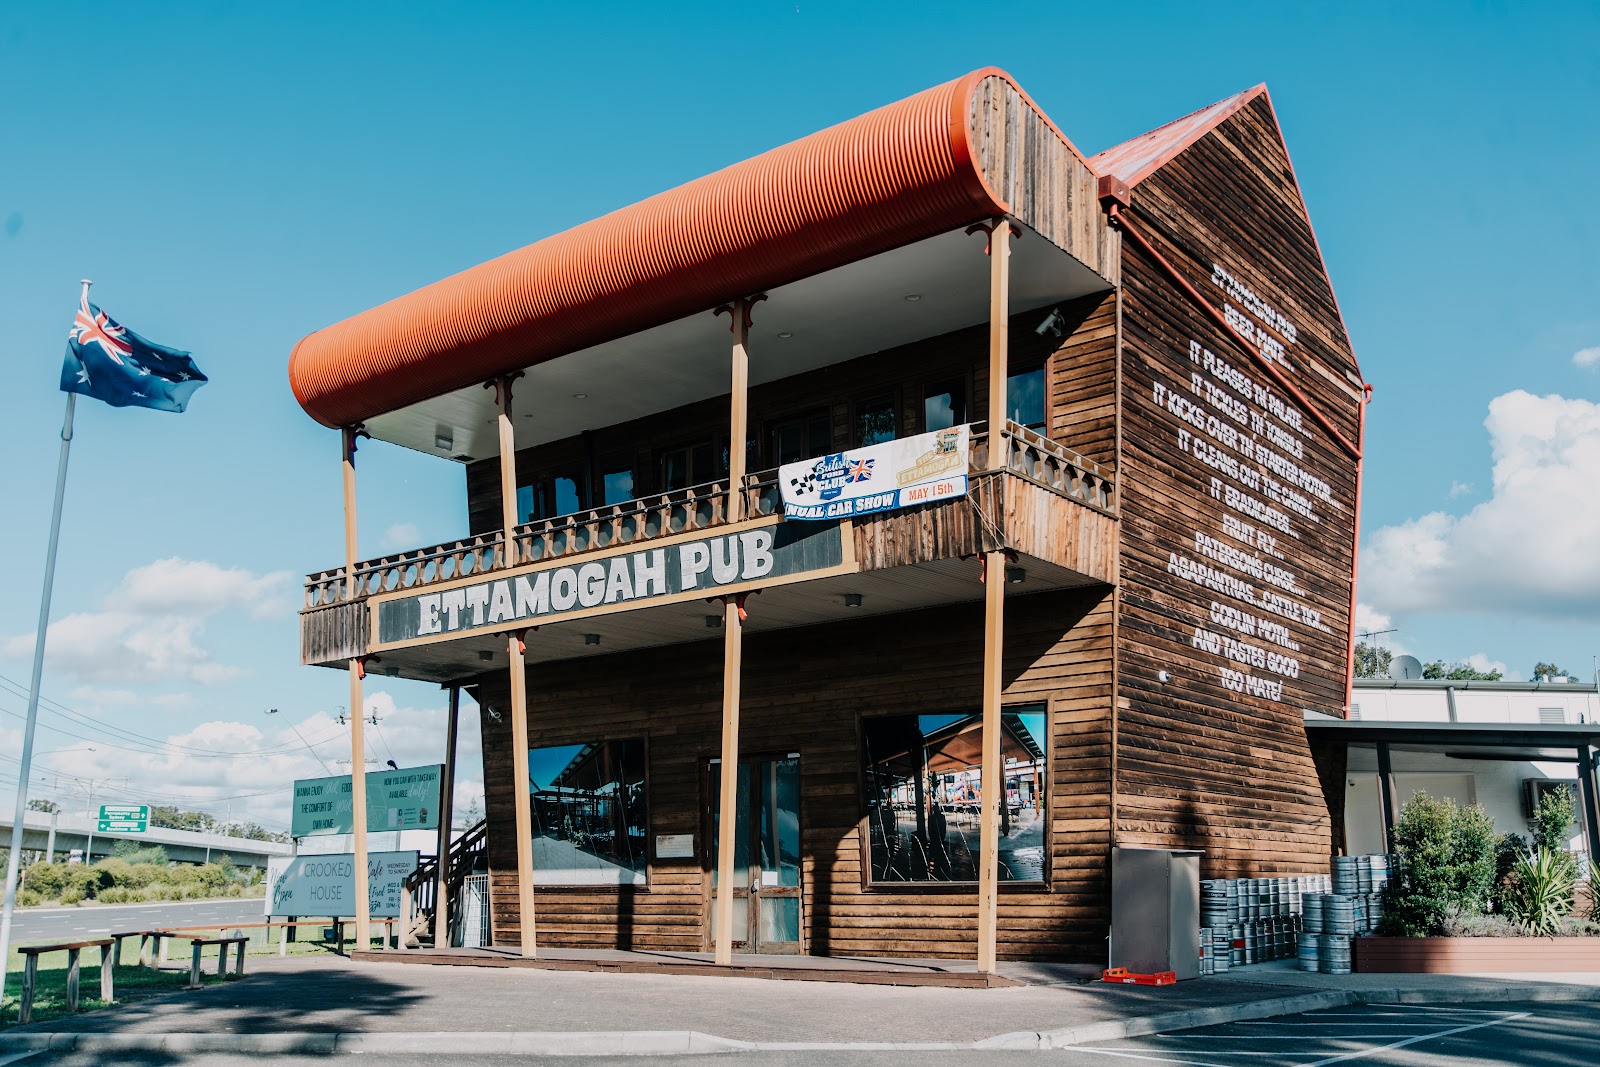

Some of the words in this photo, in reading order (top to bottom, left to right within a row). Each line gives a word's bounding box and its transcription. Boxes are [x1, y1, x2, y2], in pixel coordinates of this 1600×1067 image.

[1224, 303, 1254, 343] BEER
[1276, 313, 1297, 343] PUB
[1190, 340, 1202, 364] IT
[1203, 349, 1253, 399] PLEASES
[1191, 372, 1203, 396] IT
[1204, 380, 1248, 425] TICKLES
[1266, 420, 1303, 460] TONSILS
[1153, 381, 1166, 407] IT
[1168, 390, 1205, 430] KICKS
[1207, 416, 1238, 451] OVER
[1256, 444, 1300, 486] STARTER
[816, 455, 850, 475] British
[821, 470, 845, 480] FORD
[1178, 428, 1191, 452] IT
[1193, 438, 1239, 480] CLEANS
[1239, 464, 1260, 491] OUT
[1262, 476, 1281, 502] THE
[818, 476, 847, 491] CLUB
[908, 488, 928, 501] MAY
[1210, 476, 1223, 500] IT
[828, 500, 853, 517] CAR
[855, 493, 895, 512] SHOW
[1222, 513, 1256, 546] FRUIT
[417, 548, 666, 636] ETTAMOGAH
[679, 530, 775, 592] PUB
[1210, 601, 1256, 638] CODLIN
[1192, 627, 1221, 655] AND
[1222, 636, 1266, 669] TASTES
[1267, 651, 1300, 679] GOOD
[1218, 667, 1244, 693] TOO
[1245, 674, 1283, 702] MATE!
[417, 772, 438, 782] TAKEAWAY
[296, 786, 310, 797] WANNA
[311, 785, 324, 796] ENJOY
[389, 790, 408, 799] AVAILABLE
[301, 803, 309, 814] THE
[309, 802, 327, 813] COMFORT
[327, 801, 333, 811] OF
[304, 862, 352, 878] CROOKED
[273, 885, 293, 909] Open
[309, 885, 342, 901] HOUSE
